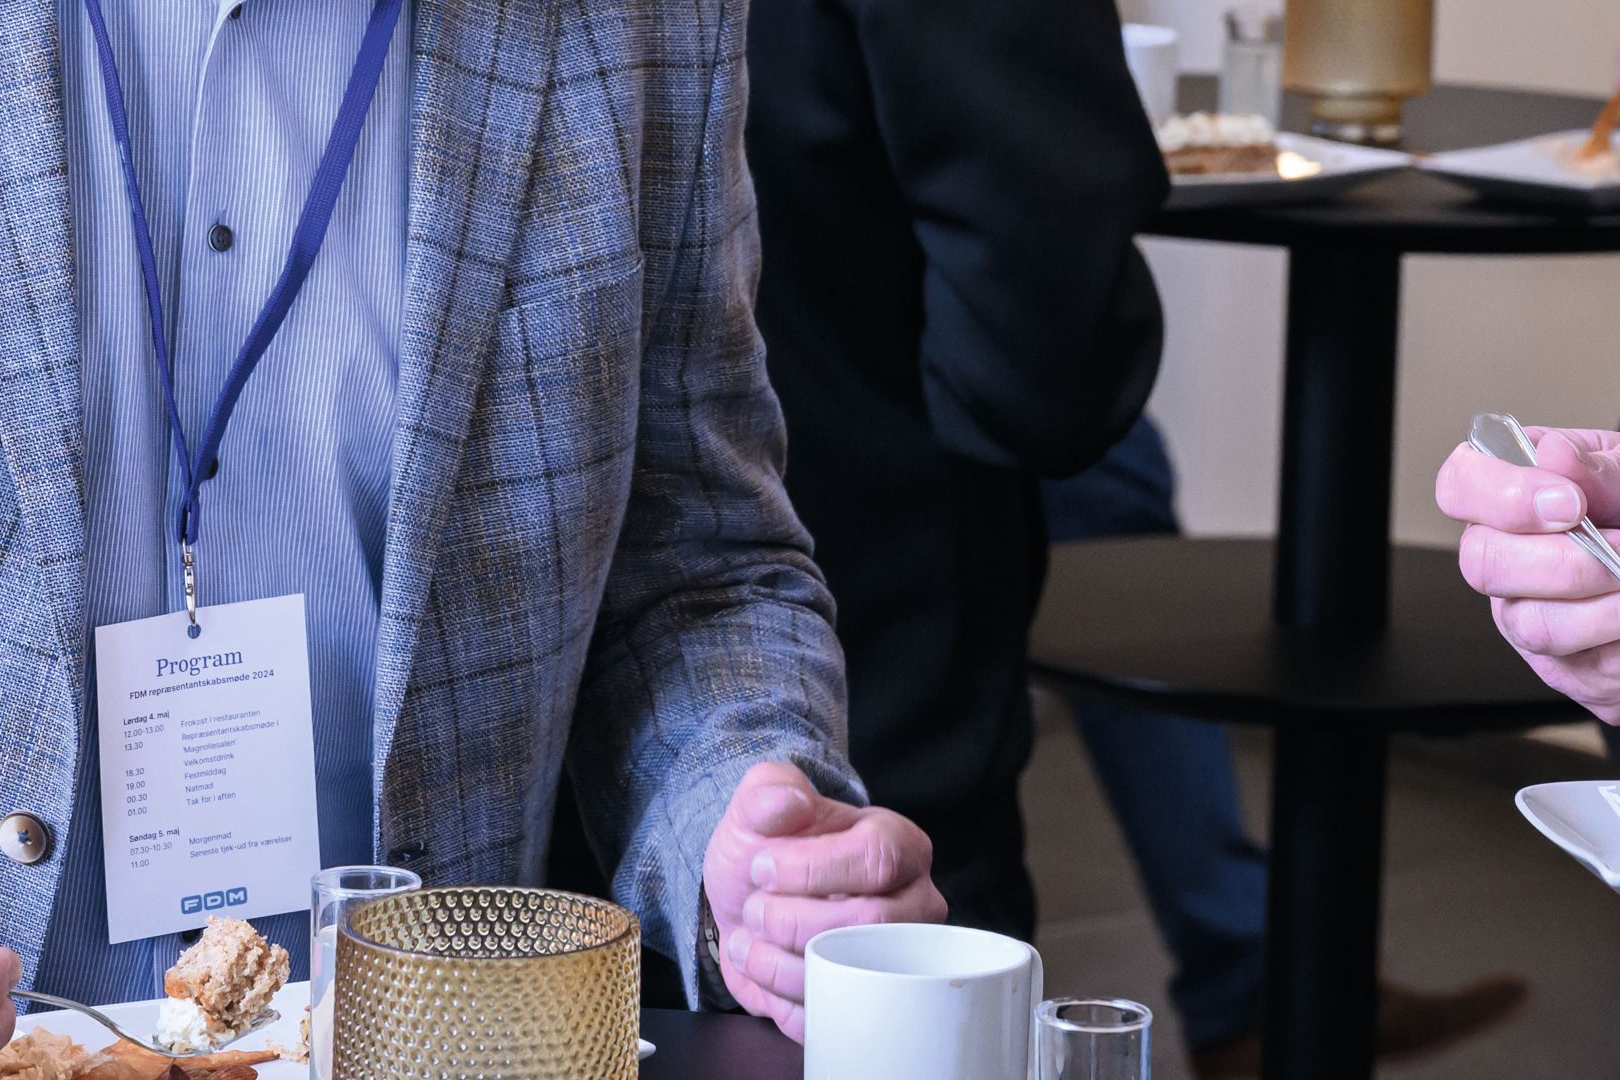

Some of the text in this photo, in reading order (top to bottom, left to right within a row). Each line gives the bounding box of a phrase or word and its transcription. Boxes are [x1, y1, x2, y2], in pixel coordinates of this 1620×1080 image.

[156, 650, 243, 677] Program
[130, 669, 274, 700] FDM repræsentantskabsmøde 2024
[123, 714, 148, 726] Lørdag
[156, 710, 170, 719] maj
[180, 717, 208, 728] Frokost
[213, 710, 261, 723] restauranten
[124, 724, 165, 738] 12.00-13.00
[181, 720, 274, 741] Repræsentantskabsmøde
[124, 741, 144, 751] 13.30
[183, 752, 235, 767] Velkomstdrink
[125, 767, 145, 778] 18.30
[184, 767, 227, 780] Festmiddag
[126, 780, 146, 791] 19.00
[185, 782, 214, 793] Natmad
[126, 793, 148, 804] 00.30
[186, 796, 200, 806] Tak
[201, 795, 211, 804] for
[217, 791, 236, 801] aften
[127, 806, 147, 817] 01.00
[129, 826, 180, 843] Søndag 5. maj
[188, 832, 232, 846] Morgenmad
[130, 841, 173, 856] 07.30-10.30
[190, 834, 293, 859] Seneste tjek-ud fra værelser
[131, 859, 149, 870] 11.00
[182, 888, 246, 913] FDM
